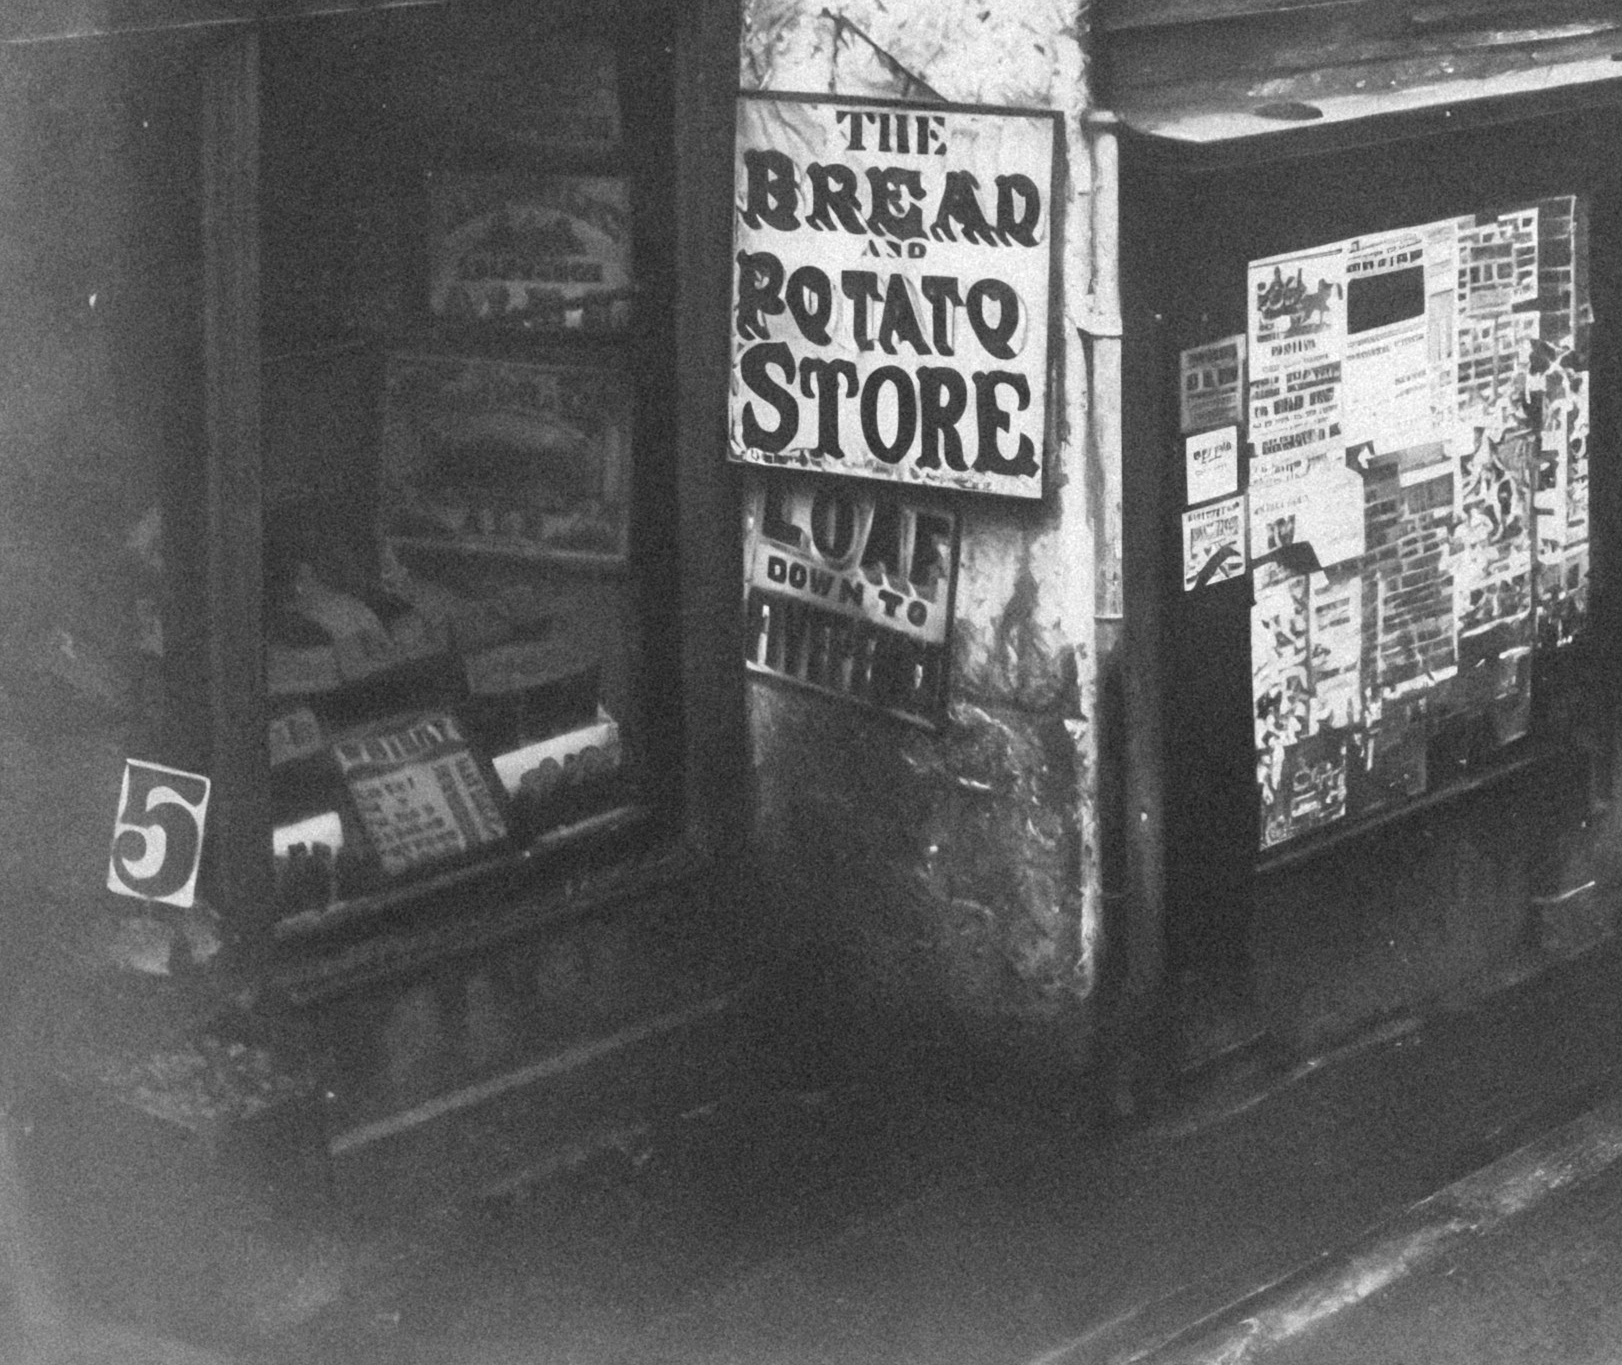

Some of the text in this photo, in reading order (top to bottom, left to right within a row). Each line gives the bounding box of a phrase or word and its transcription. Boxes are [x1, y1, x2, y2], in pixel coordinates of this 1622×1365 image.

[836, 110, 948, 156] THE
[737, 148, 1042, 248] BREAD
[863, 238, 927, 260] AND
[736, 248, 1021, 361] POTATO
[740, 341, 1040, 478] STORE
[766, 554, 929, 628] DOWN TO
[112, 762, 207, 900] 5
